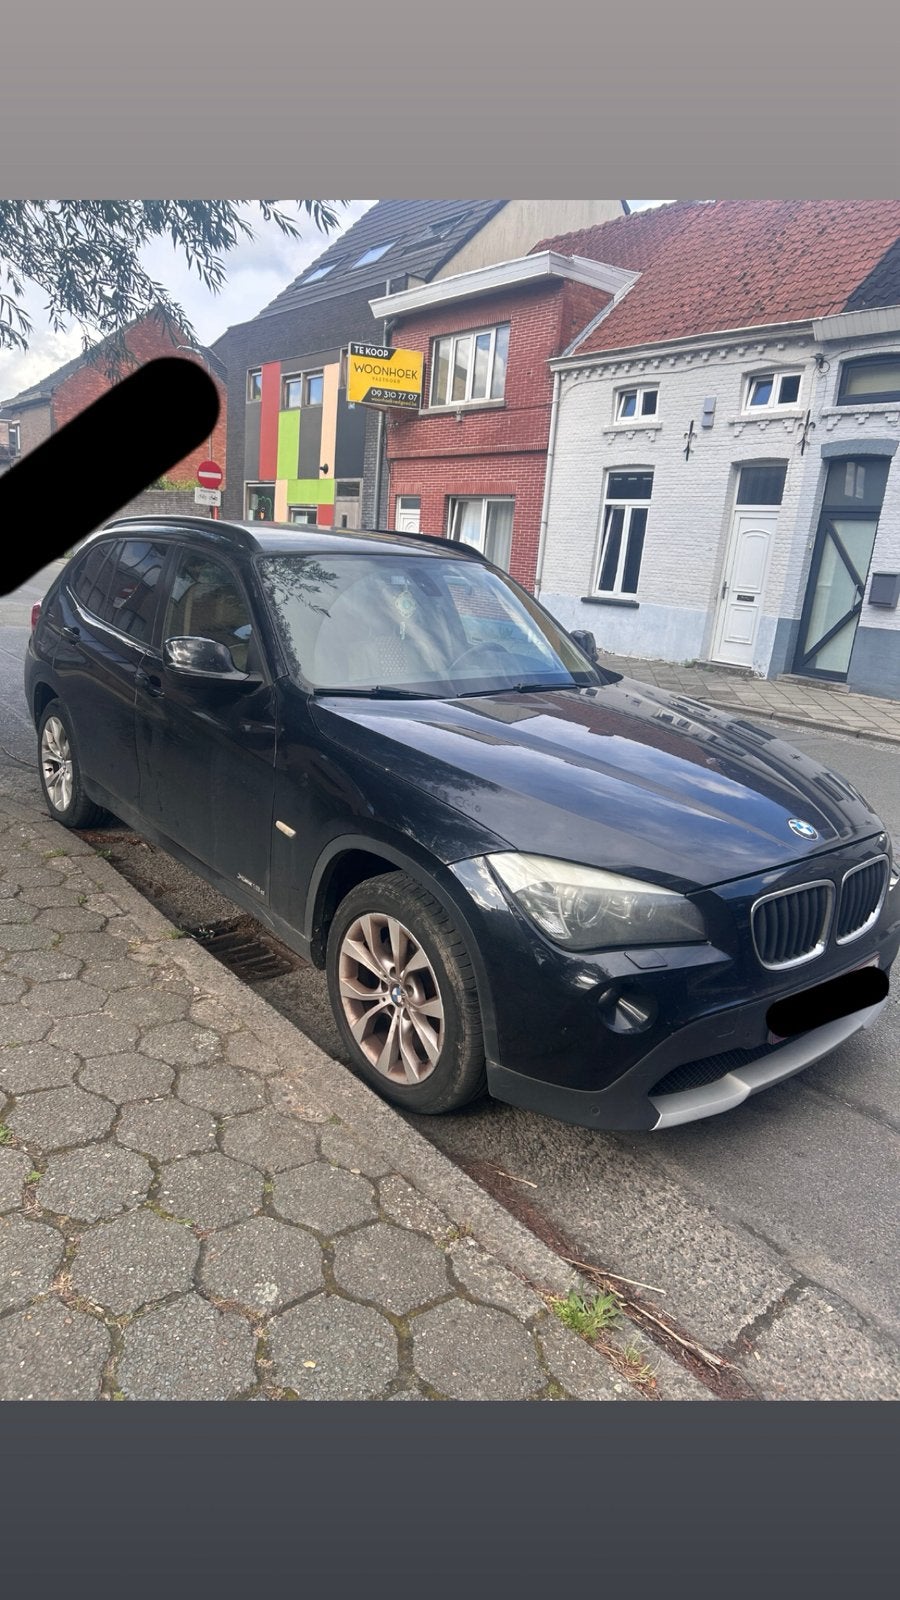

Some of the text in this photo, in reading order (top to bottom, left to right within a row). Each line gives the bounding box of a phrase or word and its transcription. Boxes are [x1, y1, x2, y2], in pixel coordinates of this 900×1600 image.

[354, 346, 389, 357] TE KOOP
[354, 362, 418, 380] WOONHOEK
[371, 389, 381, 397] 09
[384, 391, 396, 399] 310
[398, 392, 406, 400] 77
